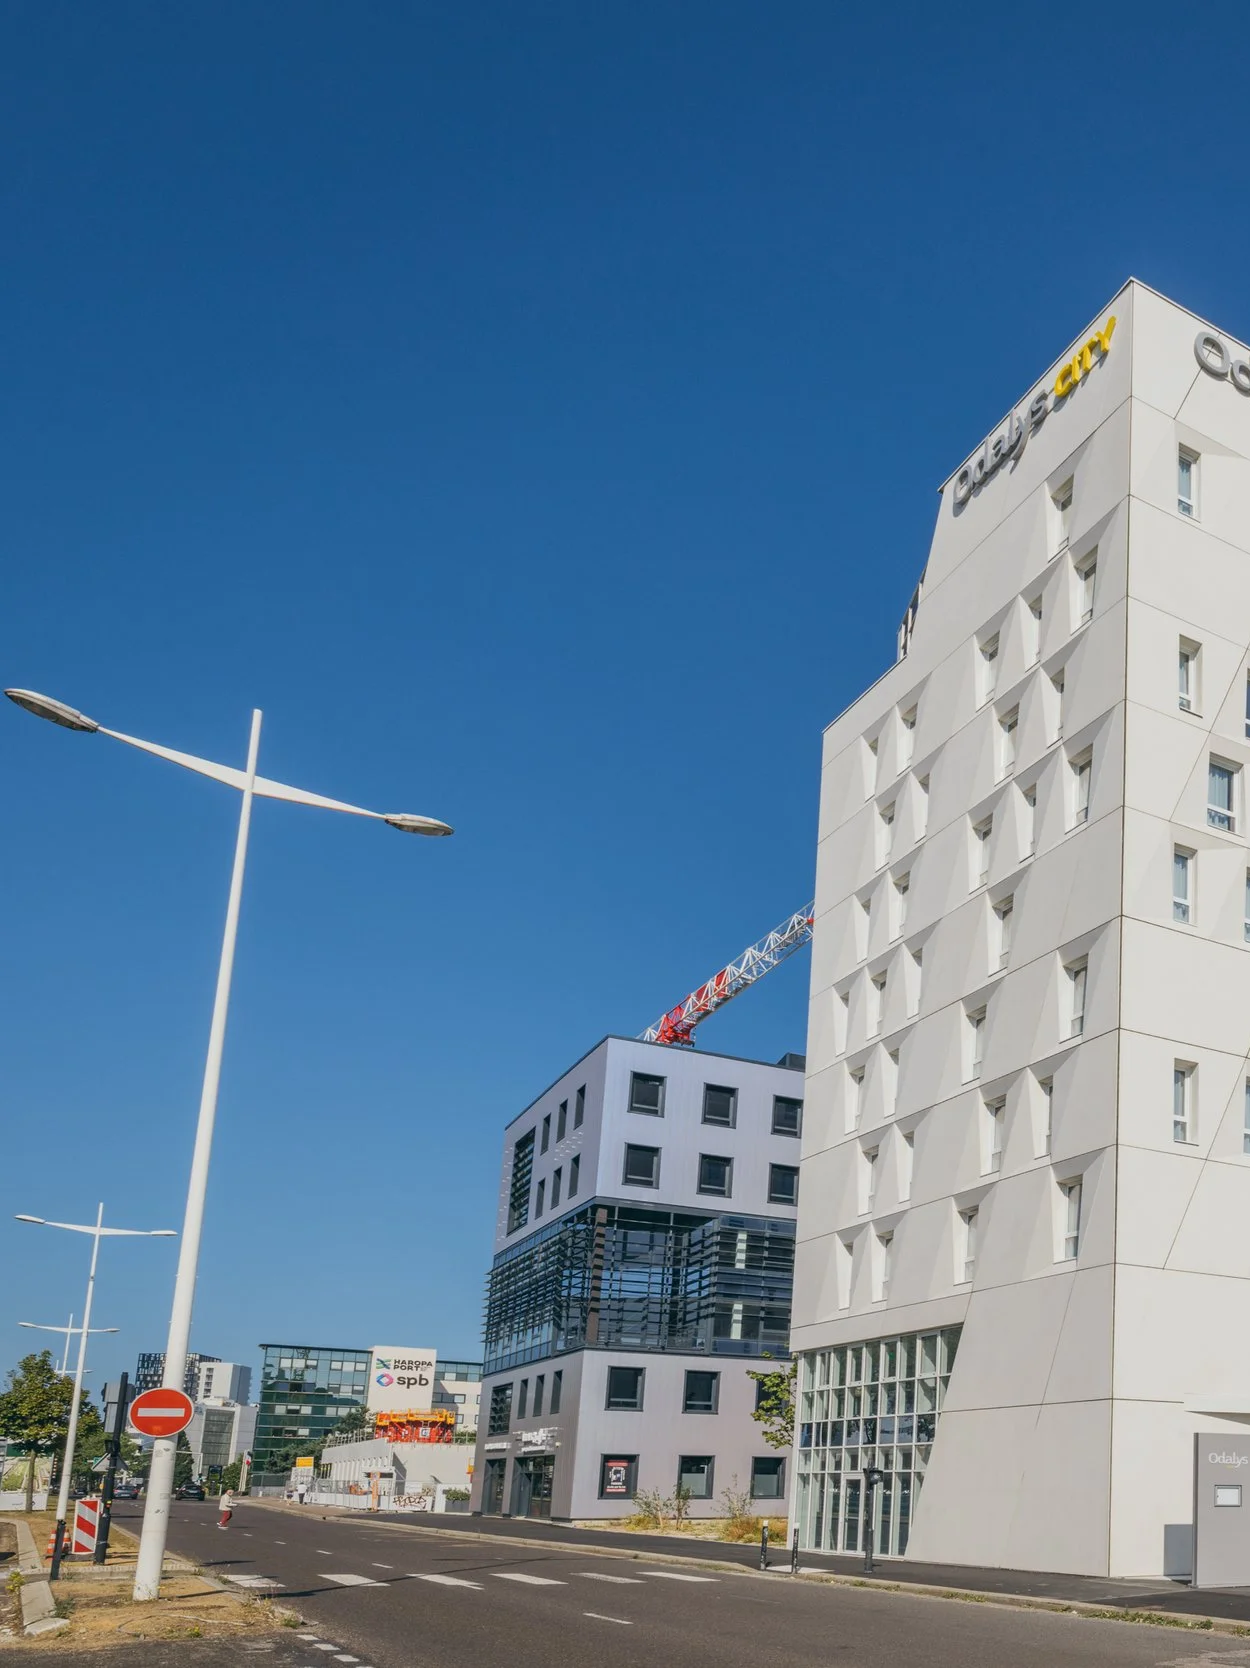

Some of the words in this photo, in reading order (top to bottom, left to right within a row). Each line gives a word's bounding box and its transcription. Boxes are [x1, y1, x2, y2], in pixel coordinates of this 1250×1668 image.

[953, 389, 1049, 506] Odalys
[1054, 315, 1117, 398] CITY
[393, 1358, 433, 1367] HAROPA
[396, 1373, 430, 1390] spb
[1208, 1451, 1249, 1468] Odalys
